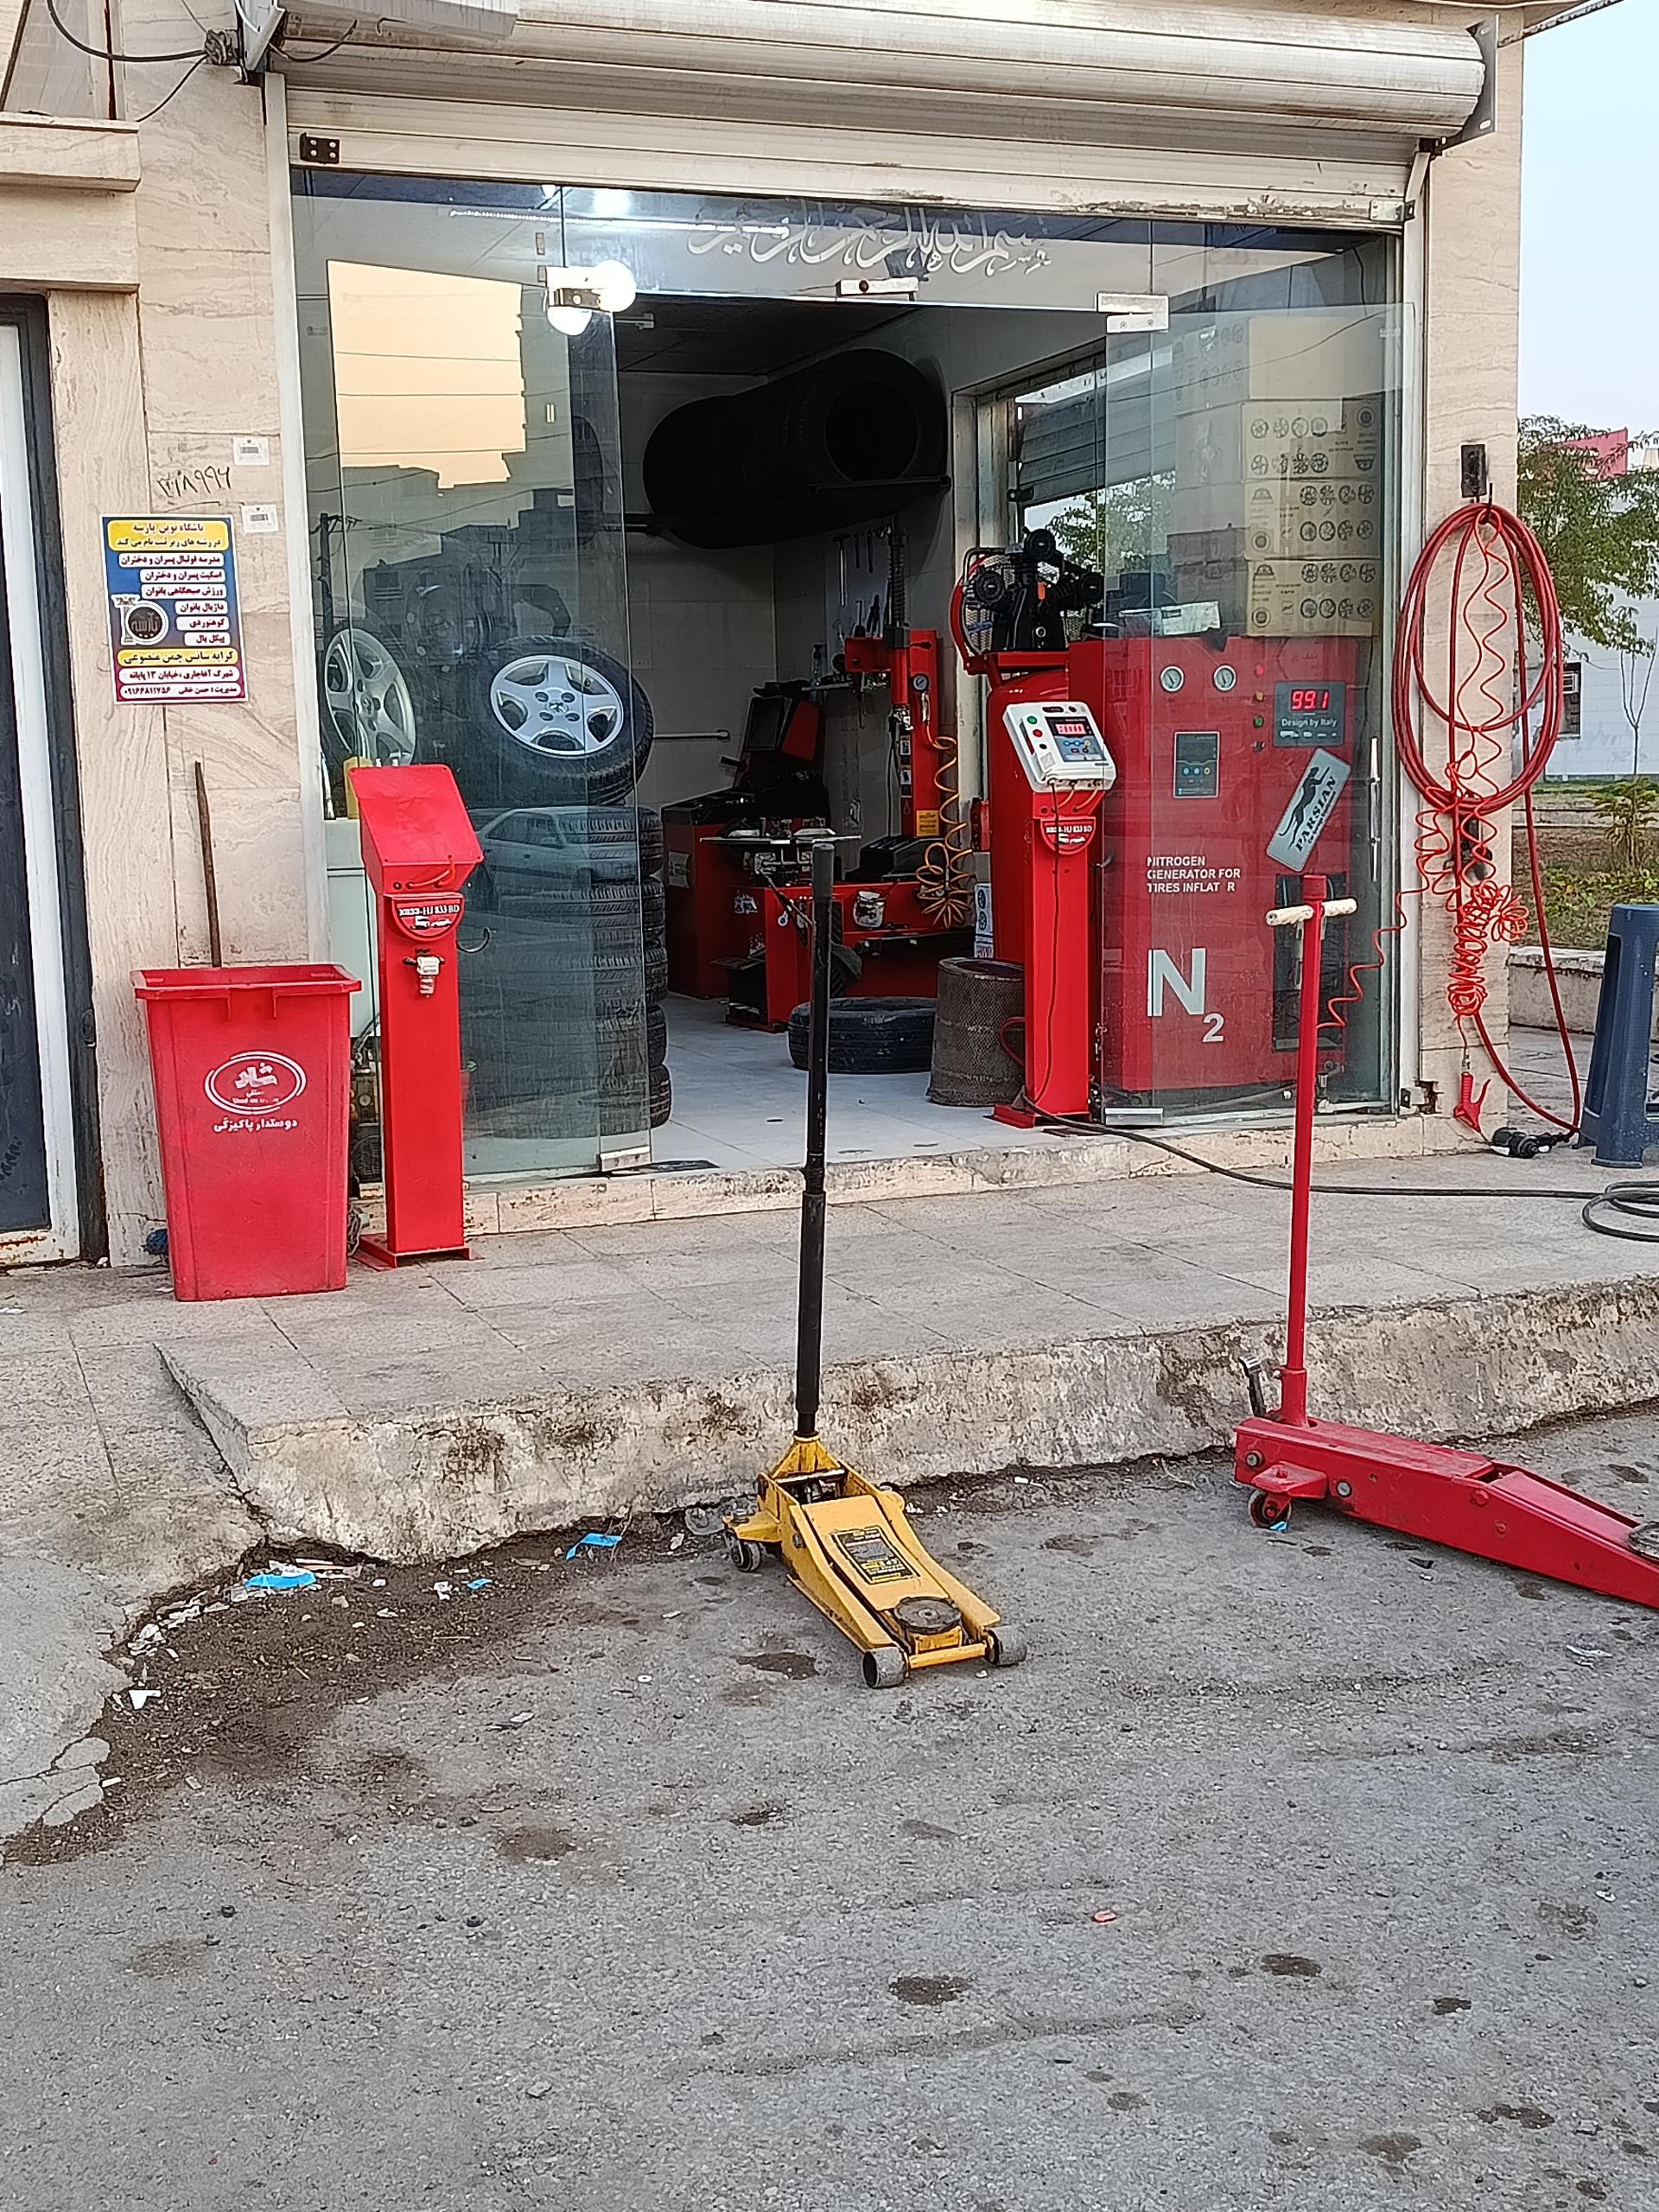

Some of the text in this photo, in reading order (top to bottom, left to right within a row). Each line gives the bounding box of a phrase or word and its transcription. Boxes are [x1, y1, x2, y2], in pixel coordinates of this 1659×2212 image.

[181, 537, 194, 547] های
[121, 555, 148, 565] دختران
[154, 555, 175, 565] پسران
[176, 555, 197, 564] فوتبال
[199, 556, 220, 565] مدرسه
[145, 570, 171, 581] دختران
[178, 570, 199, 581] پسران
[200, 570, 222, 579] اسکیت
[145, 587, 166, 596] بانوان
[202, 587, 223, 596] ورزش
[180, 602, 200, 613] بانوان
[189, 618, 225, 628] کوهنوردی
[124, 654, 161, 664] مصنوعی
[162, 652, 182, 663] چمن
[212, 651, 233, 663] کرایه
[213, 670, 233, 679] شهرک
[1281, 718, 1338, 728] Design by Italy
[1295, 775, 1336, 852] PARSIAN
[1147, 856, 1205, 867] NITROGEN
[1147, 868, 1241, 880] GENERATOR FOR
[1147, 881, 1236, 893] TIRES INFLATR
[213, 1116, 298, 1133] دوستدار پاکیزگی
